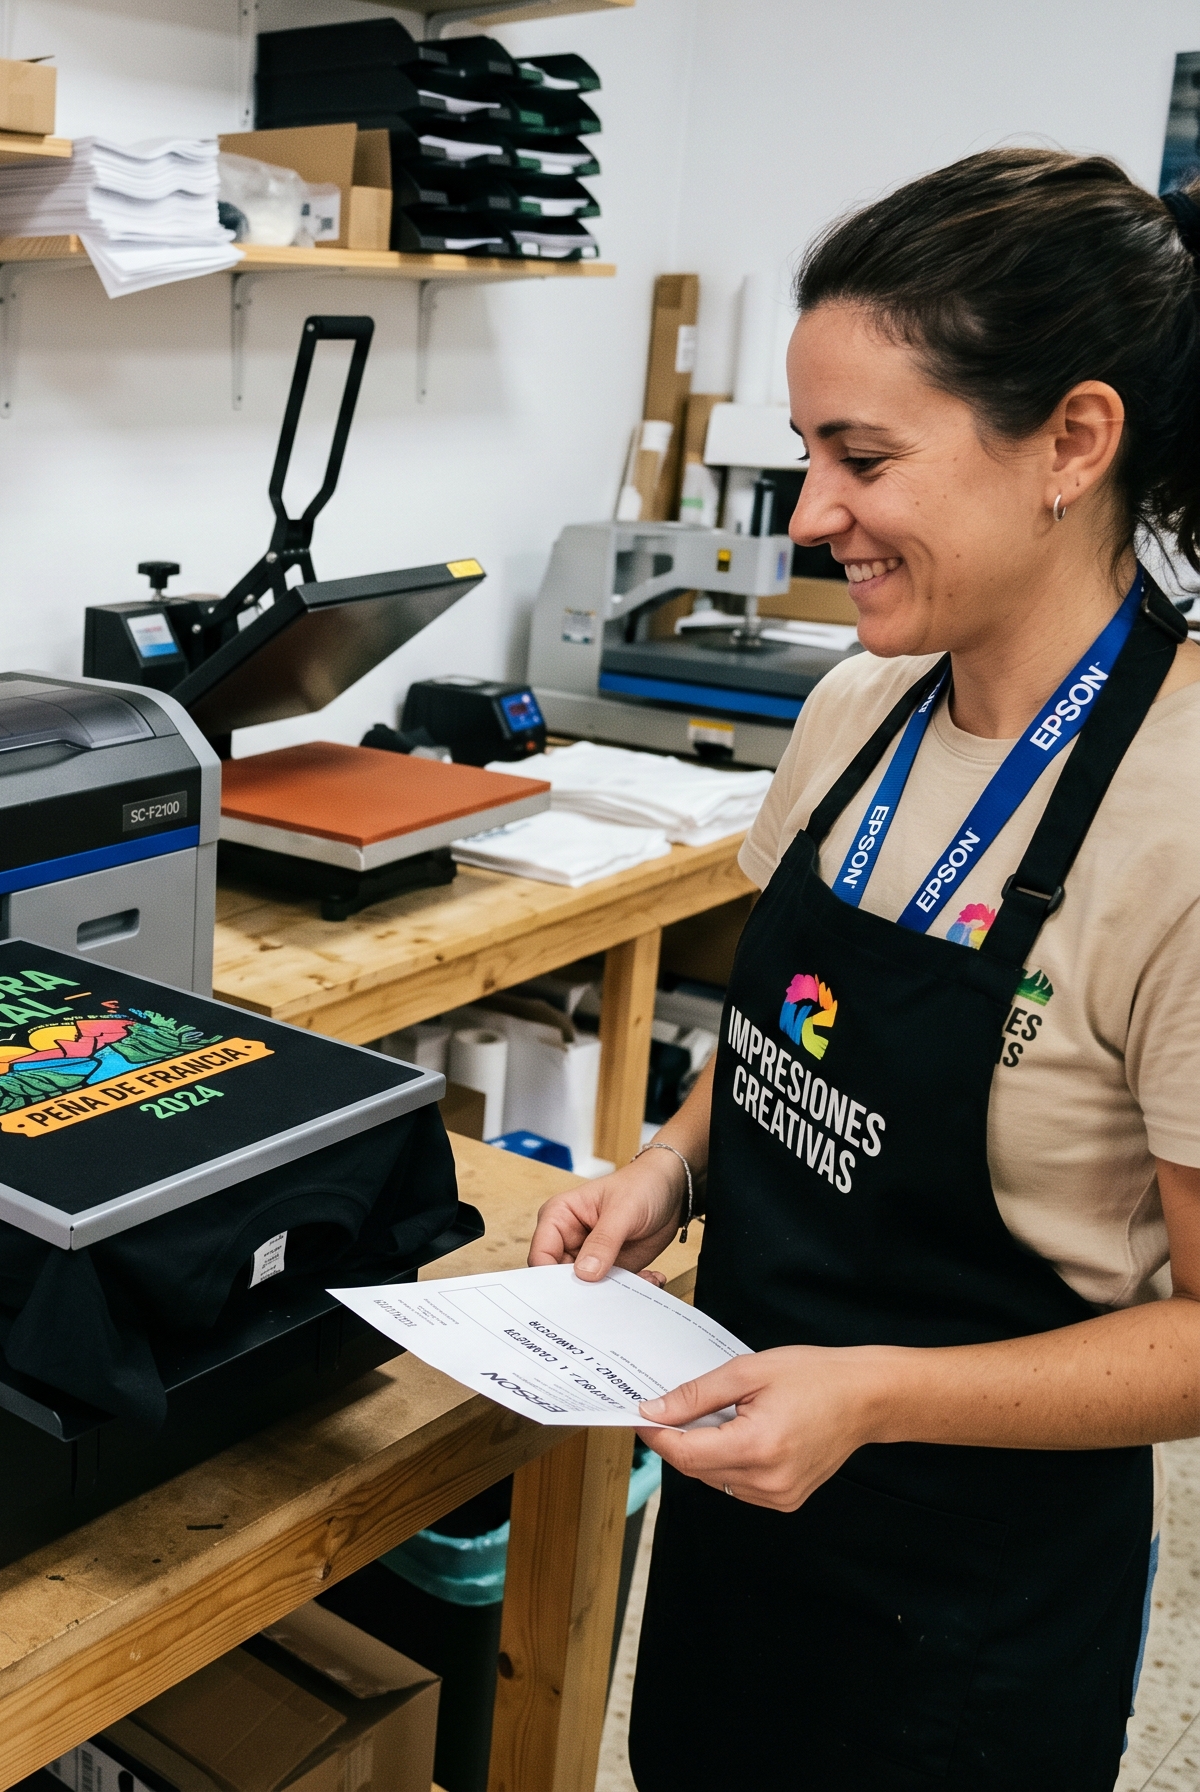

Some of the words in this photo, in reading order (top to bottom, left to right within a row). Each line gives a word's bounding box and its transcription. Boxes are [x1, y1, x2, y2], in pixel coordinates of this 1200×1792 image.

[1029, 665, 1109, 751] EPSON
[130, 801, 180, 823] SC-F2100
[843, 804, 889, 885] EPSON
[916, 831, 980, 912] EPSON
[26, 1095, 106, 1127] PEÑA
[99, 1080, 144, 1102] DE
[139, 1048, 246, 1092] FRANCIA
[139, 1084, 225, 1119] 2024
[728, 1006, 886, 1158] IMPRESIONES
[732, 1064, 856, 1193] CREATIVAS
